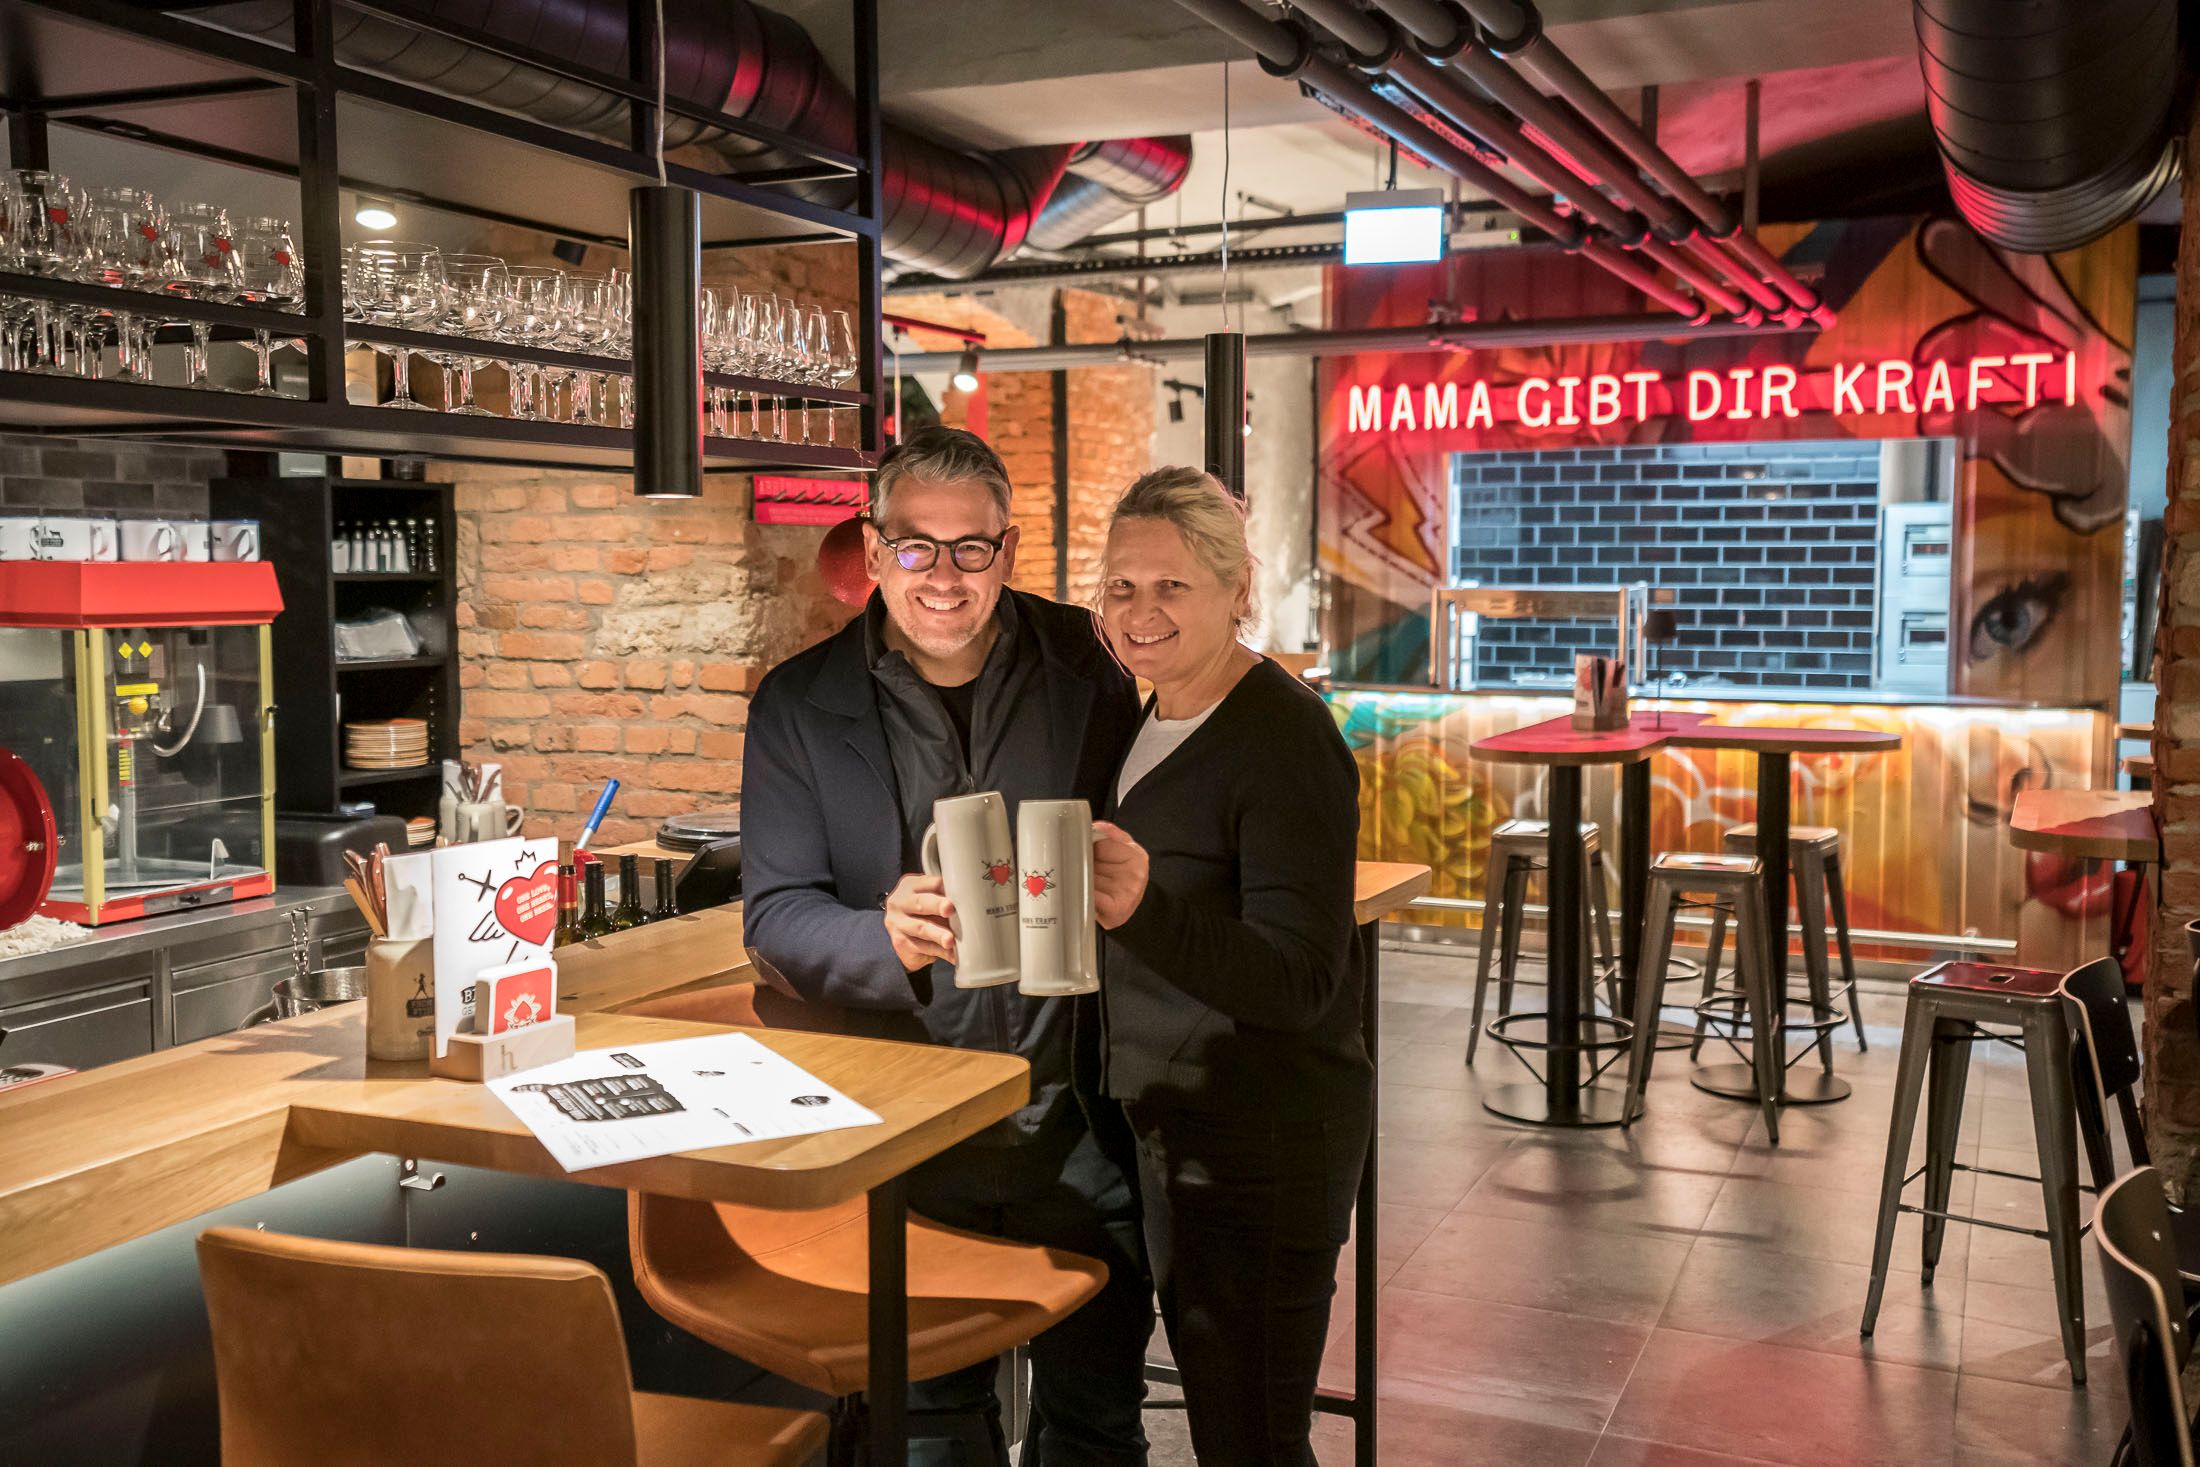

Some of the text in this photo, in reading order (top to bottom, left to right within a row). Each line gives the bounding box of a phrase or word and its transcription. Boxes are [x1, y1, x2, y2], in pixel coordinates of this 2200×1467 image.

[1348, 379, 1494, 433] MAMA
[1516, 370, 1661, 428] GIBT
[1688, 364, 1800, 422] DIR
